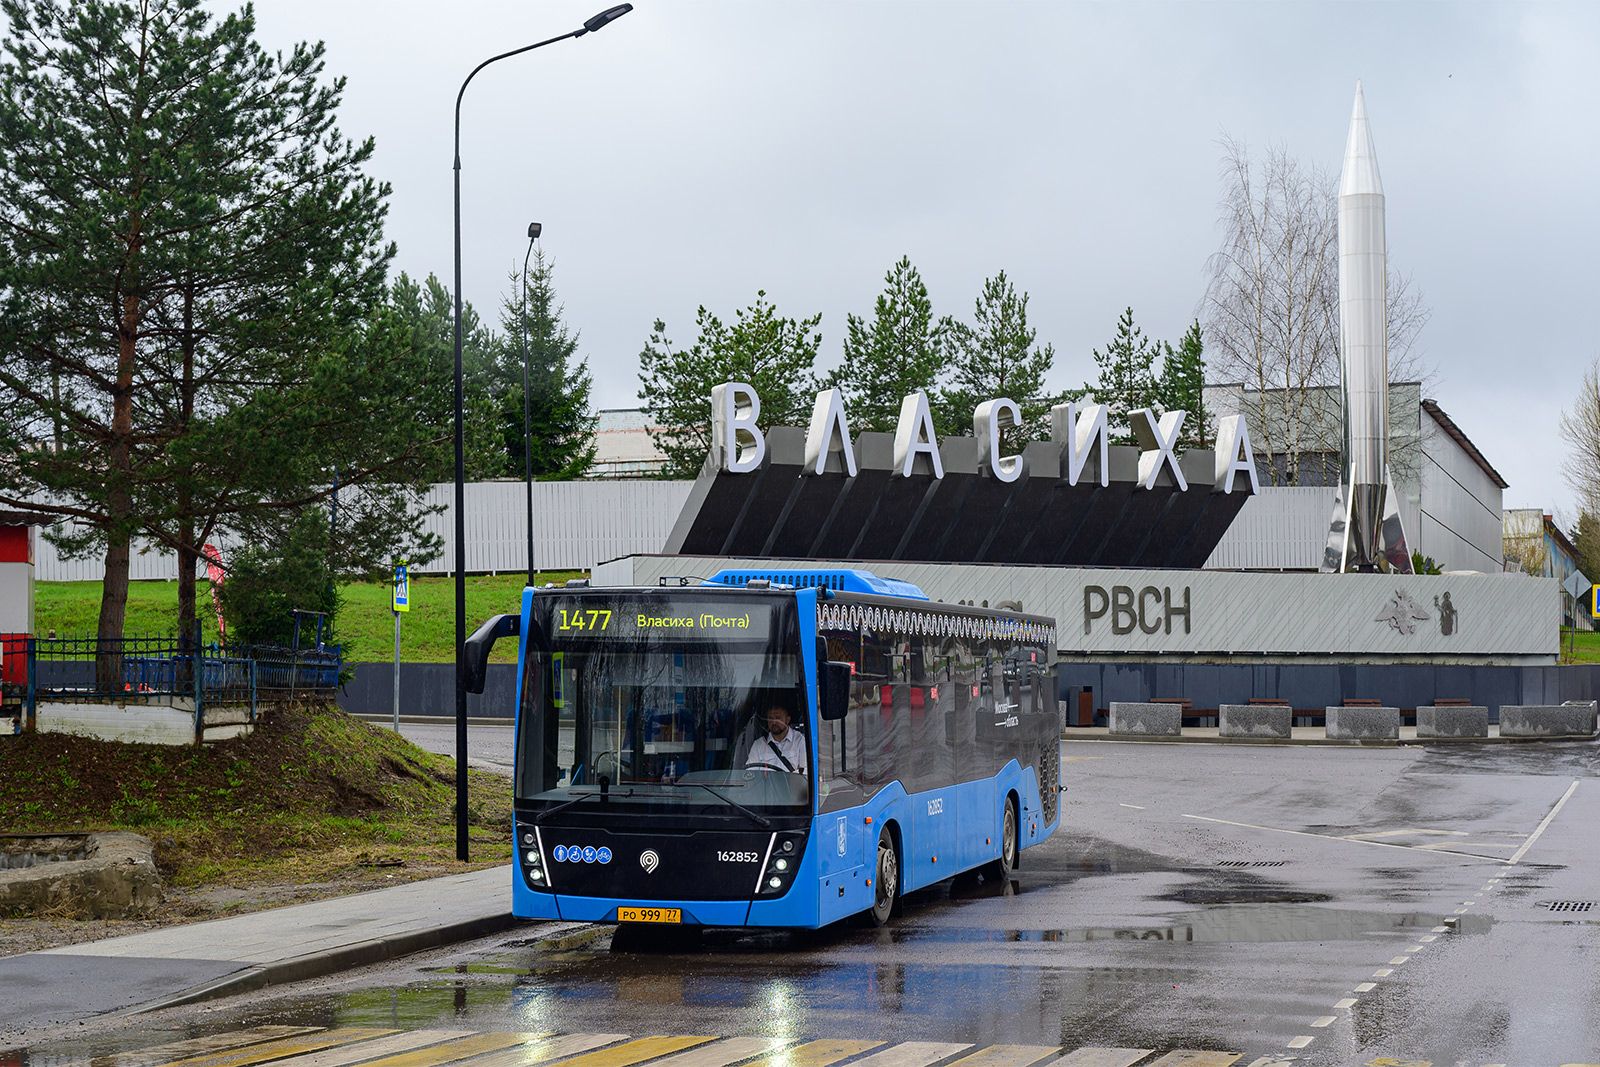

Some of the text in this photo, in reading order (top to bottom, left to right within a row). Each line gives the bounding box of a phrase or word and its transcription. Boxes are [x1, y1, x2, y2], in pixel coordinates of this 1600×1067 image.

[712, 382, 1261, 495] ВЛАСИХА
[558, 609, 750, 631] 1477 Власиха (Почта)
[1084, 585, 1191, 635] РВСН
[717, 850, 758, 863] 162852
[640, 909, 661, 921] 999
[666, 909, 678, 918] 77
